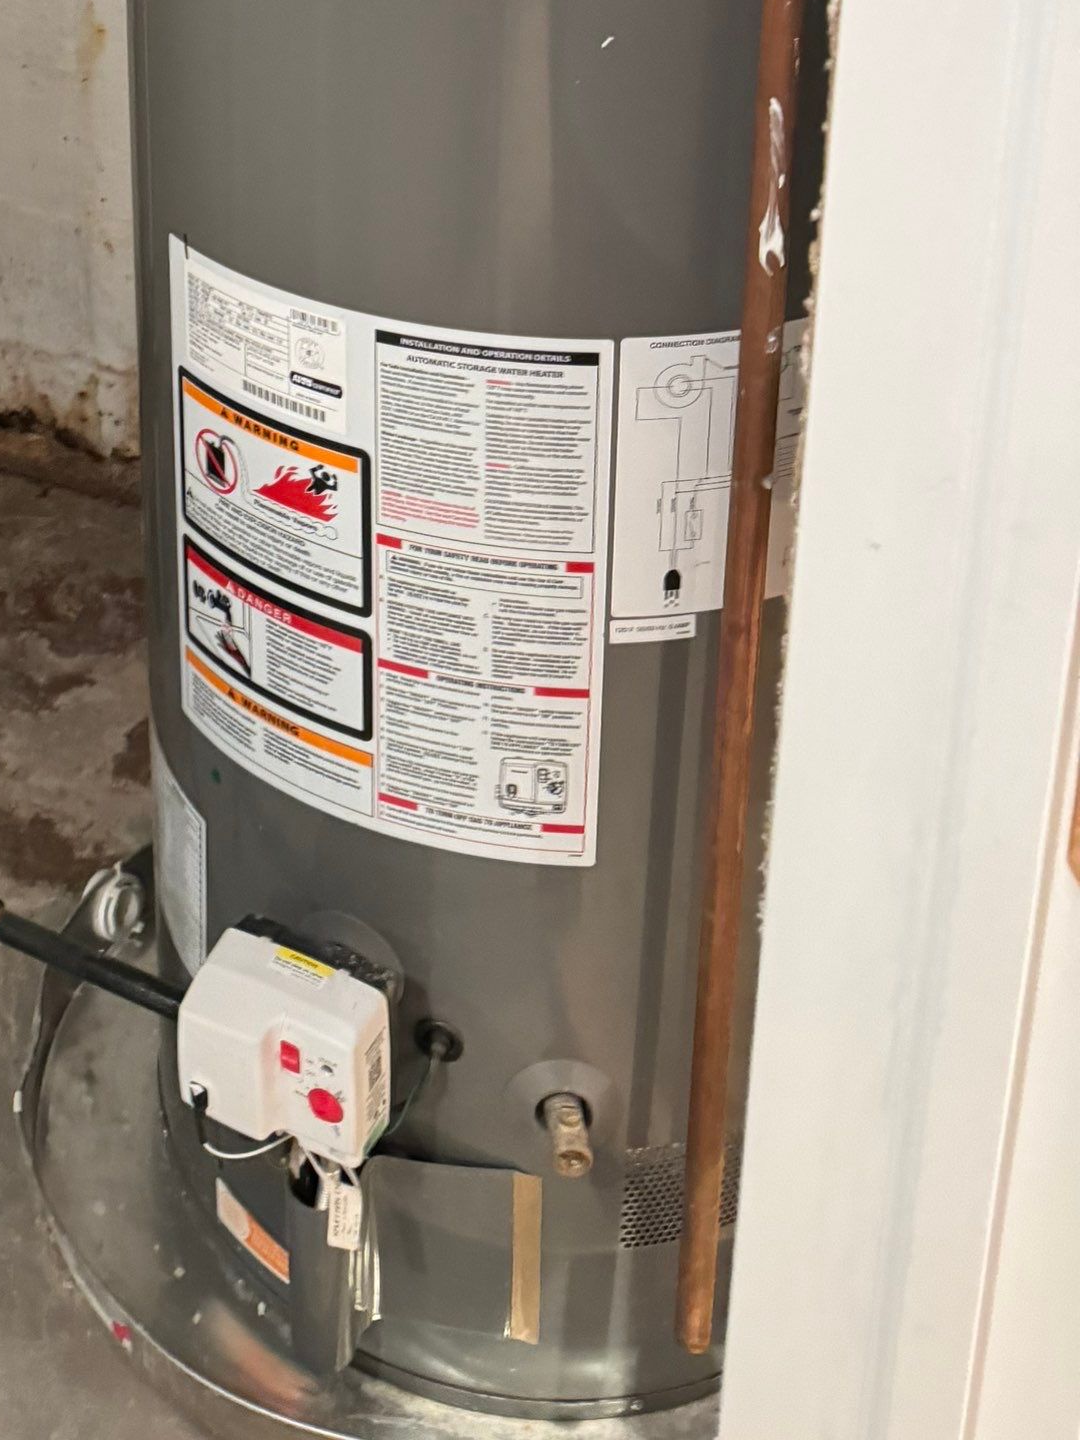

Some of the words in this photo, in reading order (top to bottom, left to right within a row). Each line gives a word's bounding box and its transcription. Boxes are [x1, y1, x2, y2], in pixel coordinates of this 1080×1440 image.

[400, 337, 460, 354] INSTALLATION
[482, 349, 533, 362] OPERATION
[650, 339, 705, 350] CONNECTION
[406, 354, 455, 369] AUTOMATIC
[456, 361, 497, 374] STORAGE
[233, 412, 300, 452] WARNING
[237, 588, 293, 625] DANGER
[241, 698, 300, 738] WARNING
